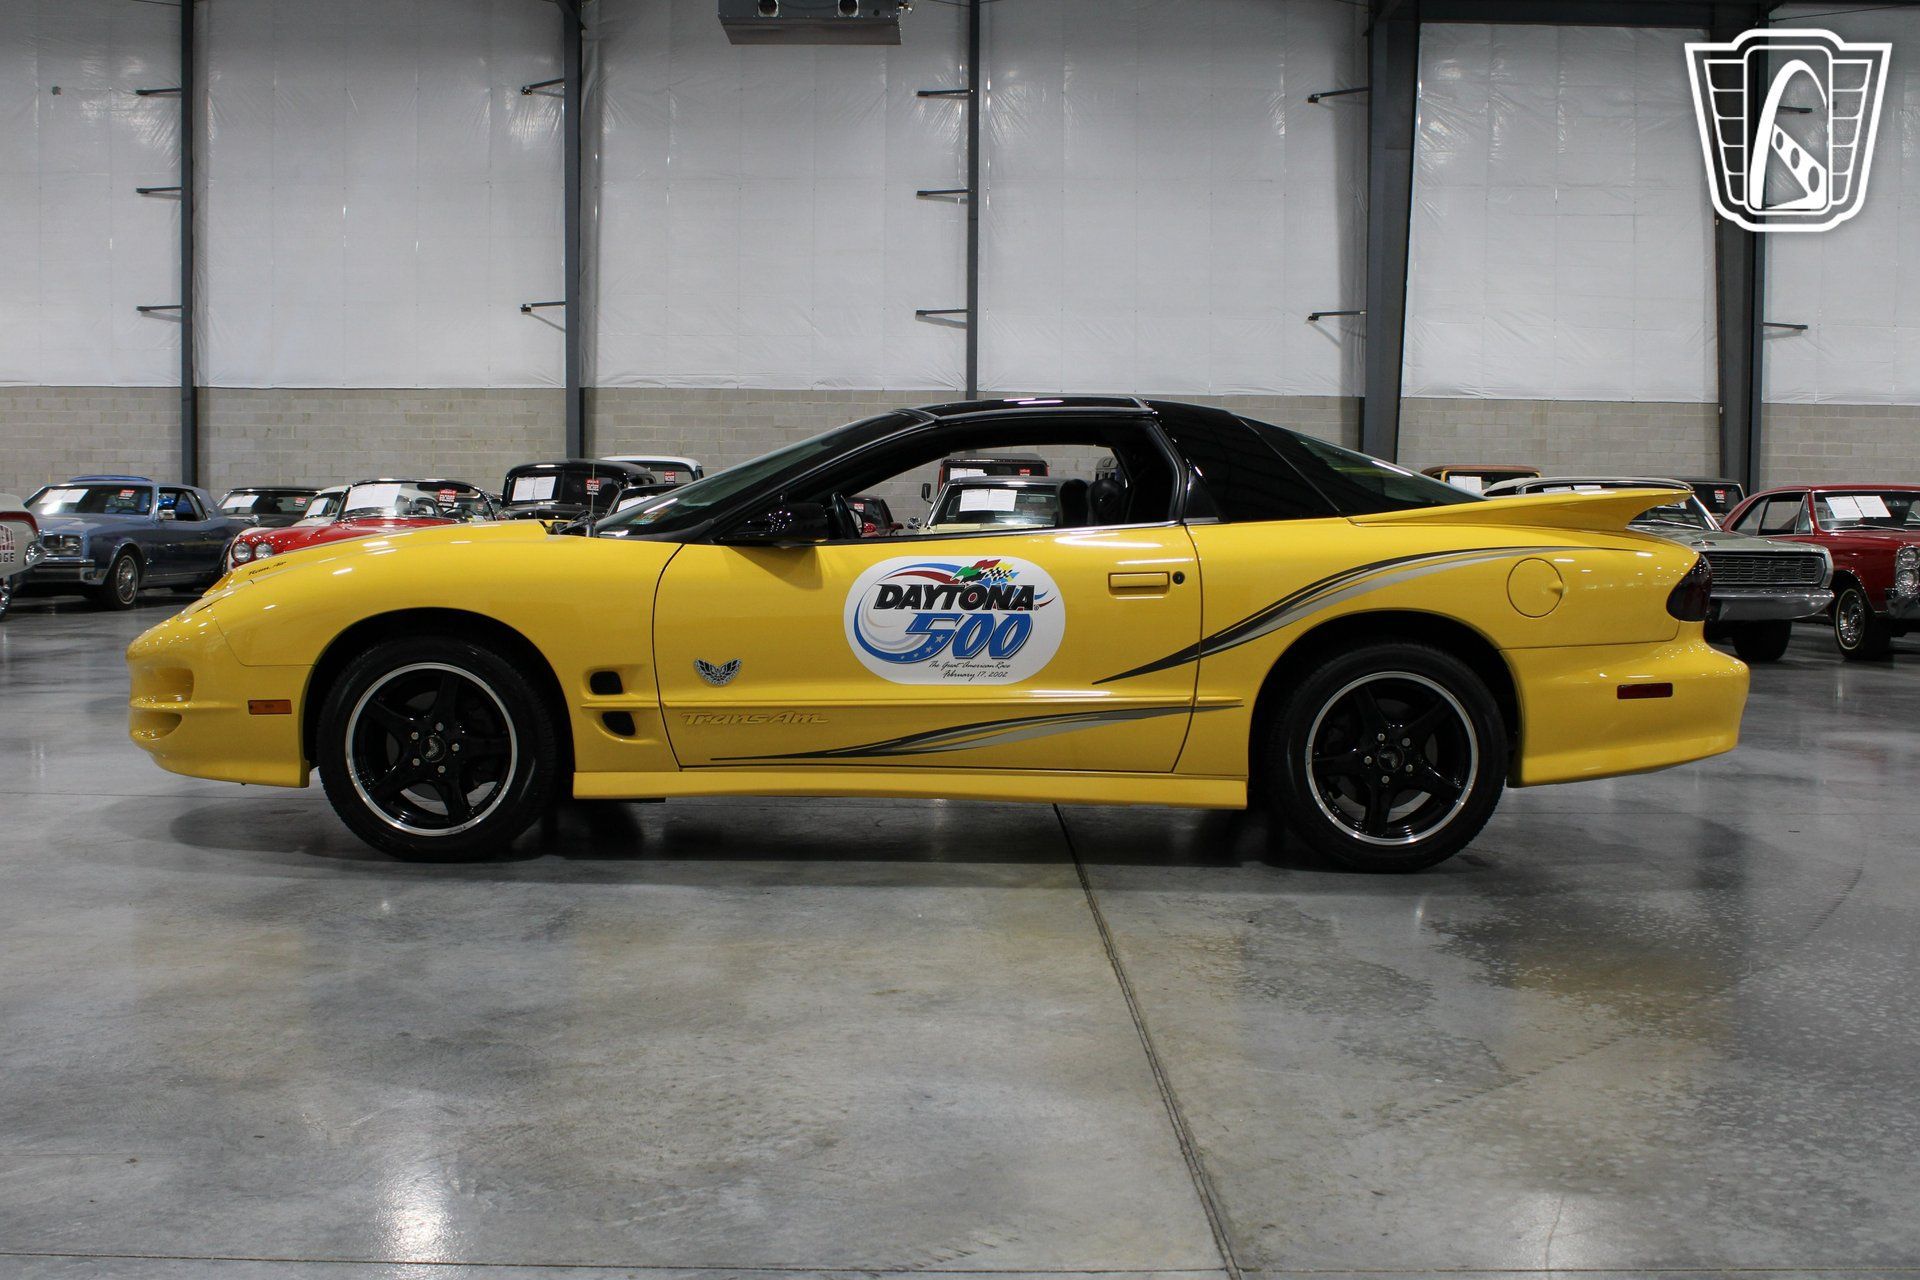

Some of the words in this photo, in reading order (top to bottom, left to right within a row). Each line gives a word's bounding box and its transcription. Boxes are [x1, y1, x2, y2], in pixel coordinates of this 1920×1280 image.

[873, 583, 1036, 611] DAYTONA
[905, 612, 1034, 660] 500
[928, 660, 940, 668] The
[995, 661, 1011, 669] Race
[942, 669, 975, 682] February
